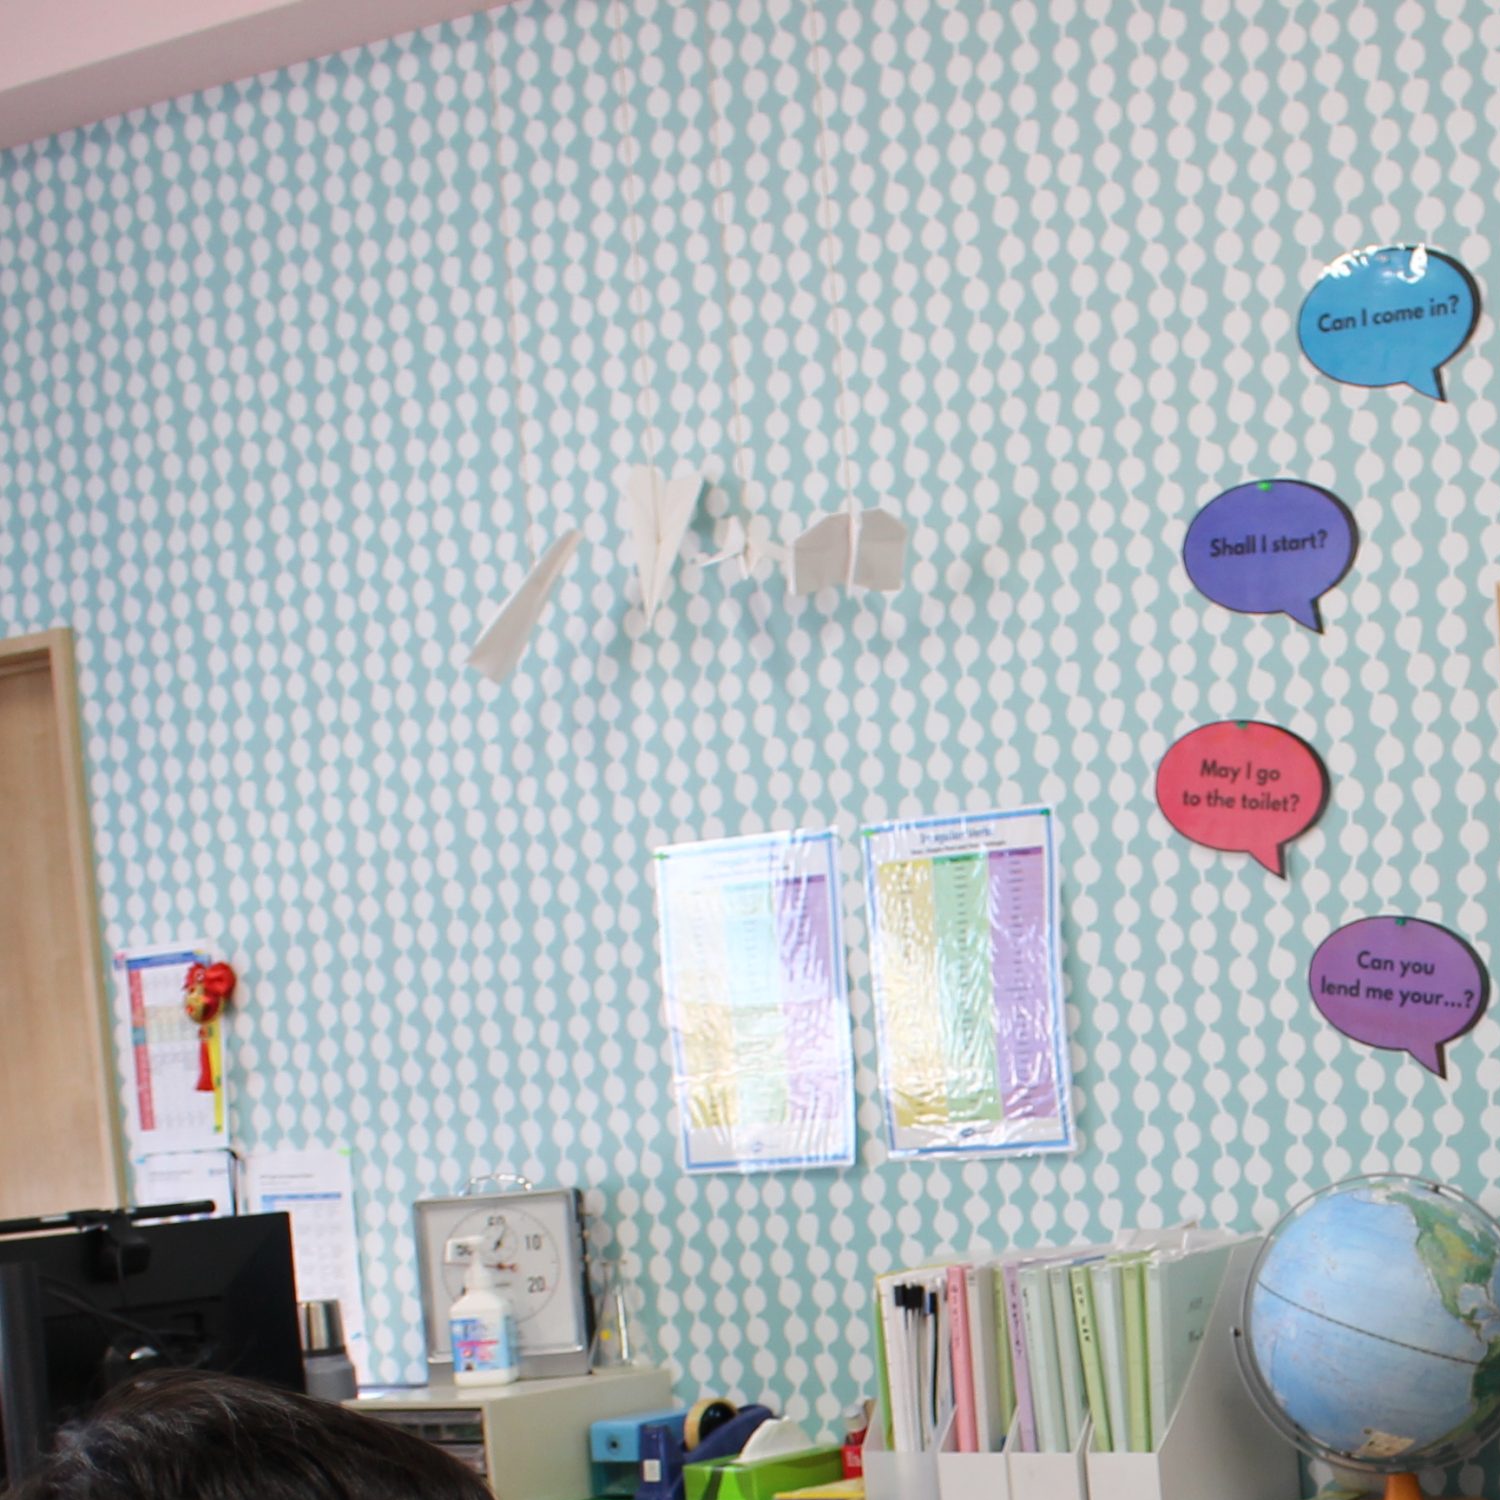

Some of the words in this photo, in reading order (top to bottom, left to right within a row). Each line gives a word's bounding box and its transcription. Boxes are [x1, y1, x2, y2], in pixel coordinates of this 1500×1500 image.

[1317, 313, 1356, 333] Can
[1372, 306, 1424, 326] come
[1429, 295, 1460, 316] in?
[1210, 536, 1256, 558] Shall
[1273, 529, 1327, 552] start?
[1201, 759, 1240, 780] May
[1256, 769, 1281, 785] go
[1182, 790, 1201, 806] to
[1206, 789, 1236, 809] the
[1241, 792, 1301, 813] toilet?
[1356, 951, 1395, 972] Can
[1399, 961, 1435, 977] you
[1320, 976, 1361, 998] lend
[1365, 984, 1394, 1001] me
[1399, 987, 1475, 1009] your...?
[525, 1234, 542, 1250] 10
[527, 1276, 546, 1293] 20
